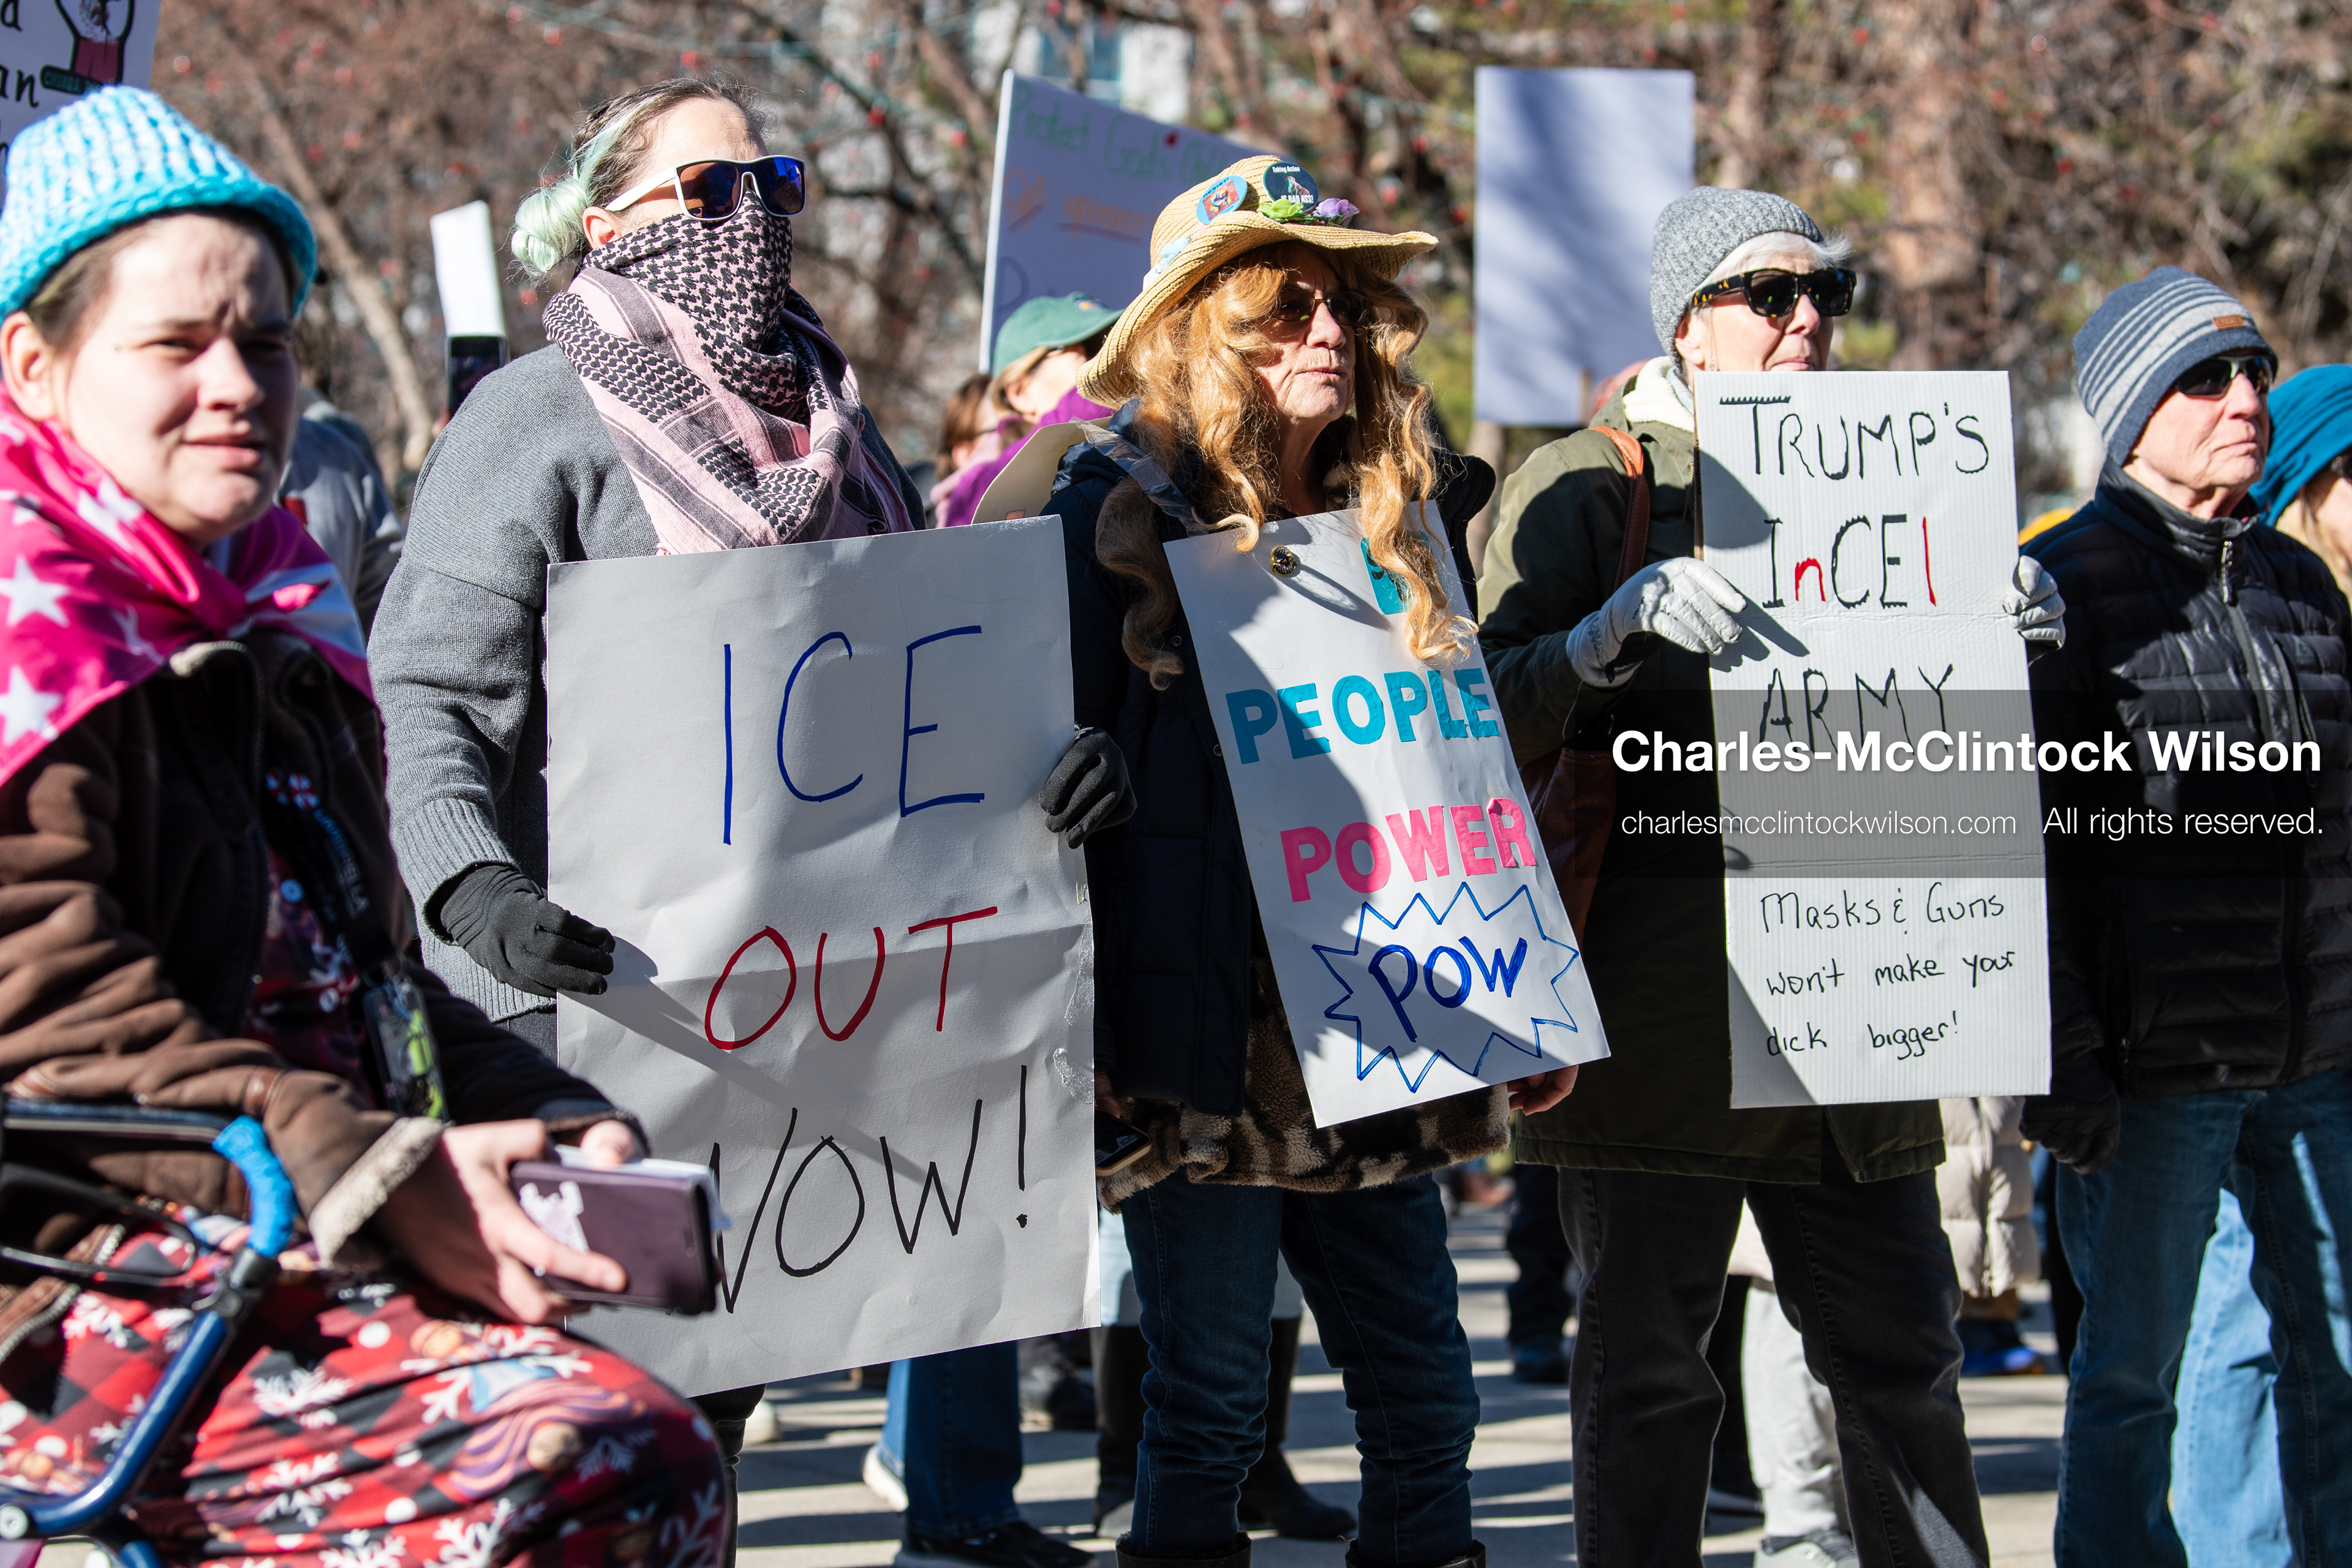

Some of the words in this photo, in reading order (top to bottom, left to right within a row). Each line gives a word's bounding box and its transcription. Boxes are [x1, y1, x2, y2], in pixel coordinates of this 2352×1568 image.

[1287, 195, 1300, 204] BAD
[1301, 194, 1314, 203] ASS!
[1719, 396, 1989, 480] TRUMP'S
[723, 625, 986, 845] ICE
[1225, 668, 1499, 764] PEOPLE
[1759, 663, 1954, 761] ARMY
[1280, 797, 1537, 903] POWER
[1760, 890, 1881, 933] Masks
[1927, 882, 2004, 923] Guns
[705, 906, 998, 1050] OUT
[1368, 936, 1528, 1042] POW
[1766, 958, 1845, 995] won't
[1875, 953, 1945, 986] make
[1962, 951, 2016, 988] your
[1766, 1022, 1827, 1056] dick
[1867, 1010, 1958, 1060] bigger!
